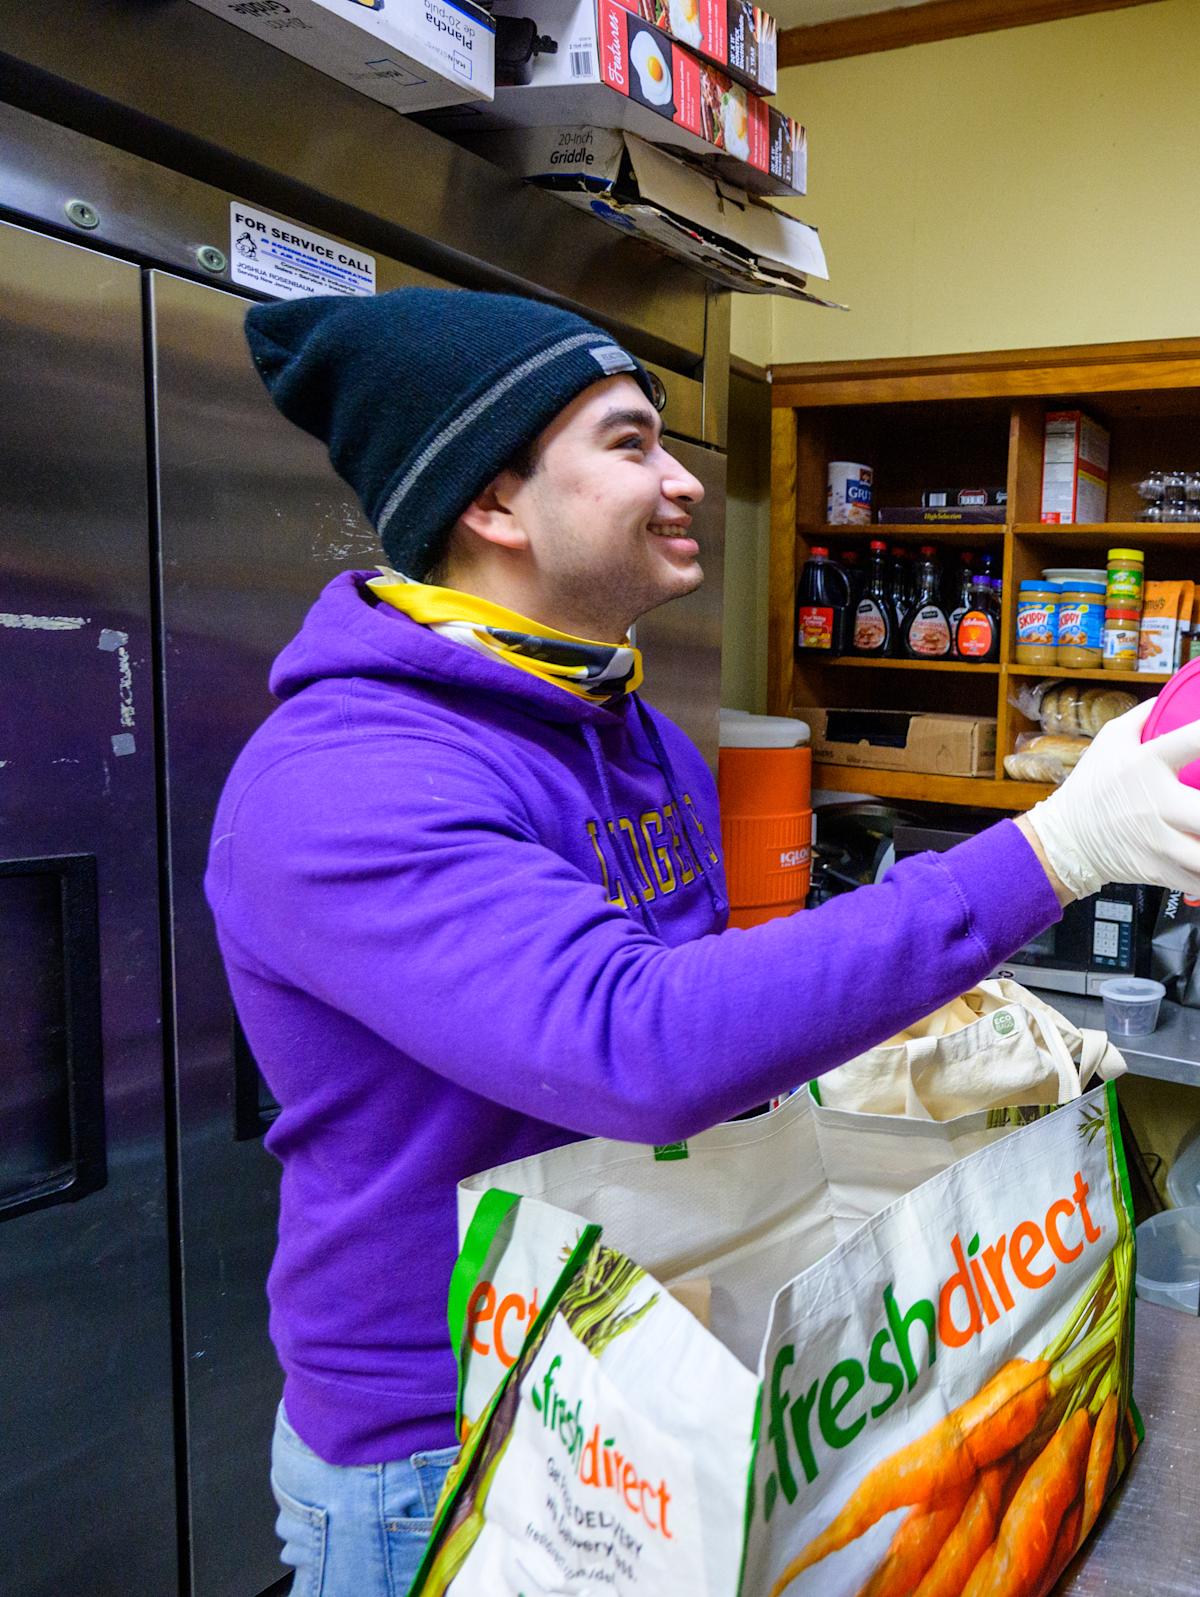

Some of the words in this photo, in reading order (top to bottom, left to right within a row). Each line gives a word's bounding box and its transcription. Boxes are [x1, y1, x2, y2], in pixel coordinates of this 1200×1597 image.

[425, 12, 473, 51] Plancha
[463, 21, 476, 38] de
[608, 10, 625, 85] Features
[558, 131, 593, 147] 20-Inch
[550, 148, 594, 165] Griddle
[235, 213, 267, 234] FOR
[271, 228, 334, 260] SERVICE
[338, 254, 372, 274] CALL
[237, 262, 268, 278] JOSHUA
[269, 273, 315, 293] ROSENBAUM
[1018, 612, 1048, 630] SKIPPY
[1059, 612, 1081, 629] KIPPY
[780, 849, 809, 865] IGLO
[993, 1014, 1011, 1025] ECO
[768, 1170, 1103, 1506] freshdirect
[541, 1355, 673, 1539] freshdirect
